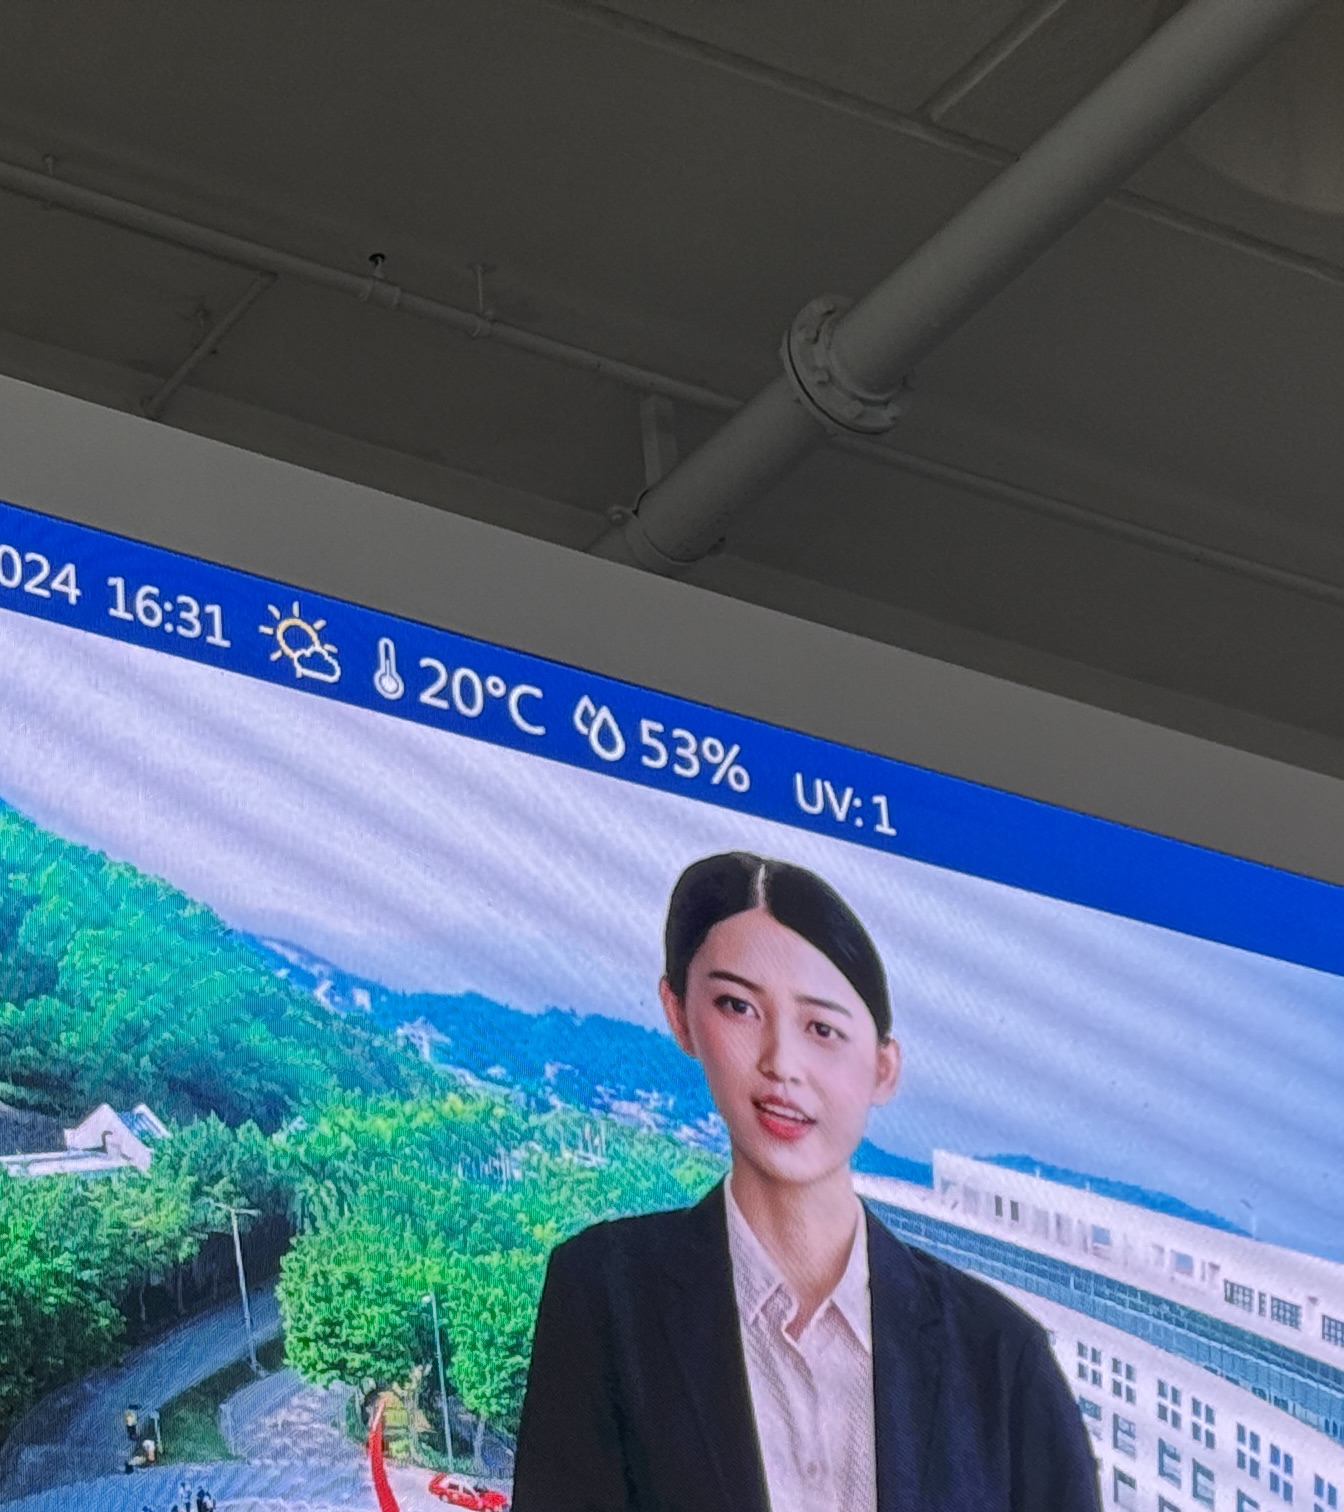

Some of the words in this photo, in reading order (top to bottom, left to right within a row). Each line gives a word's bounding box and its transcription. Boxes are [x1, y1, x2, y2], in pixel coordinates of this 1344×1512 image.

[106, 576, 232, 649] 16:31
[639, 718, 751, 793] 53%
[793, 772, 898, 837] UV:1
